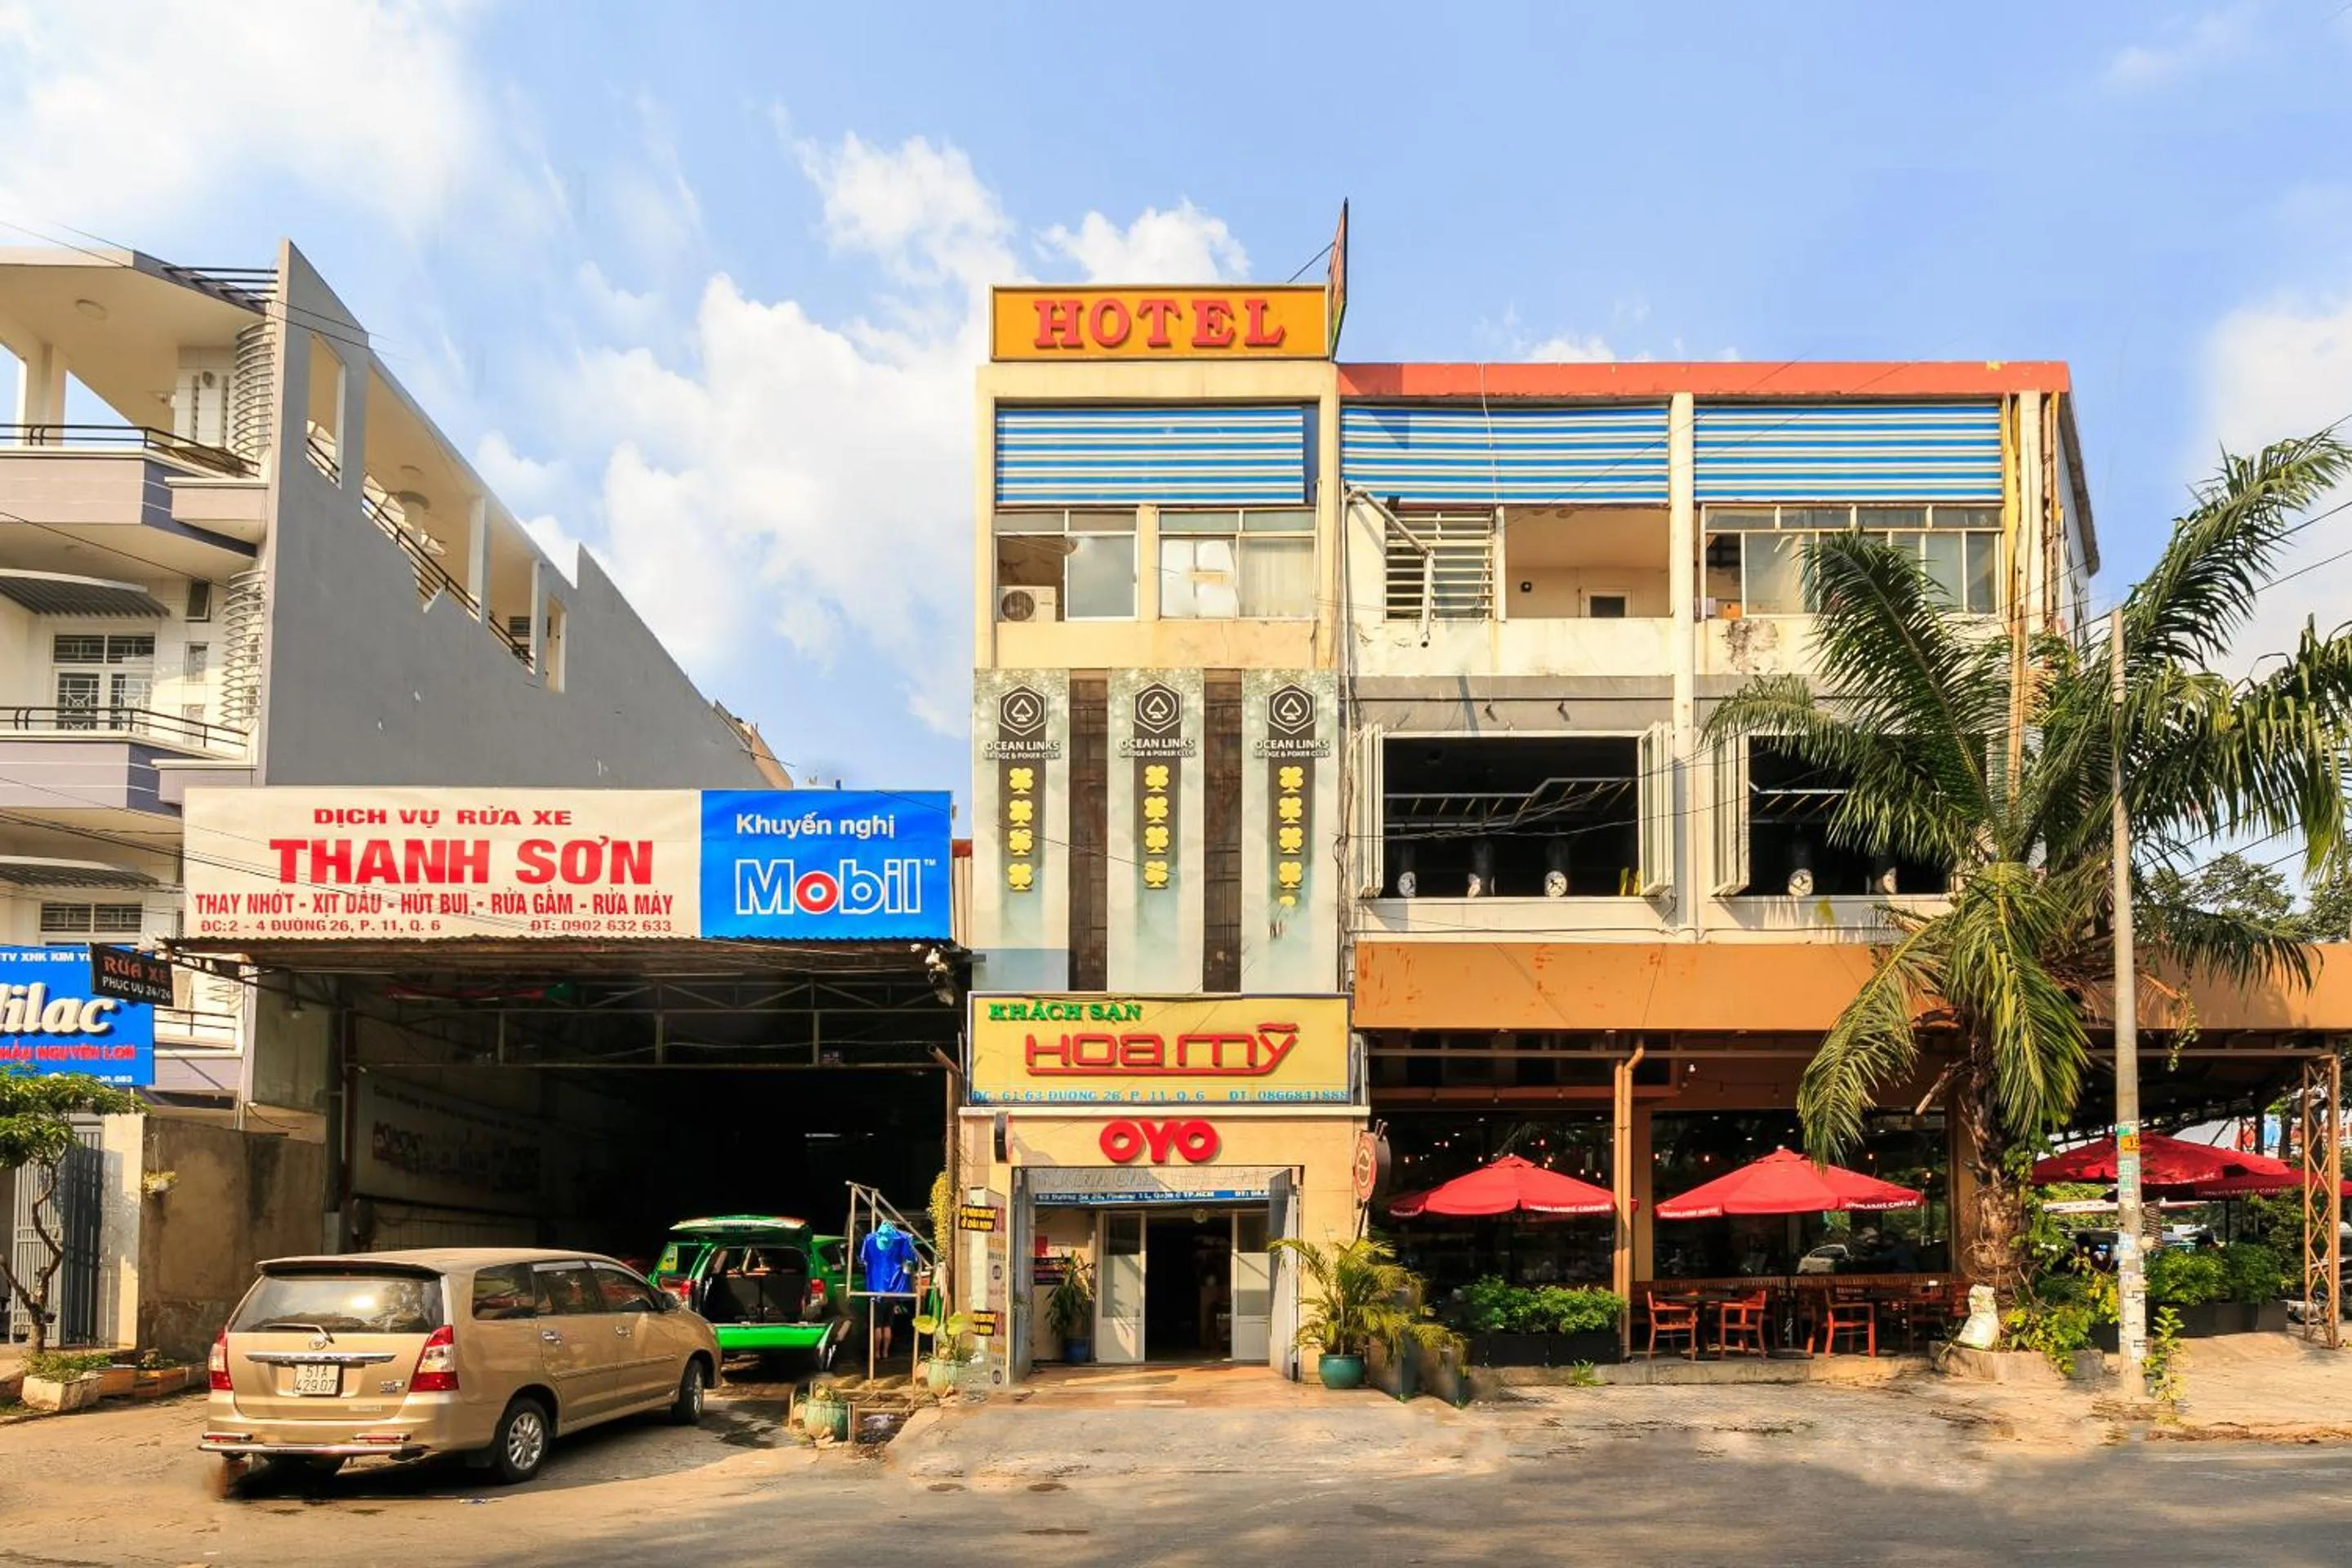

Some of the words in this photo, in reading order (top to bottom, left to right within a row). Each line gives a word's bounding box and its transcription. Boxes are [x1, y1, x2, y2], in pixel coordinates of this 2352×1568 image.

[1033, 297, 1287, 349] HOTEL
[985, 740, 1024, 751] OCEAN
[1027, 740, 1060, 751] LINKS
[1120, 737, 1160, 749] OCEAN
[1161, 737, 1195, 749] LINKS
[1254, 739, 1294, 749] OCEAN
[1296, 739, 1330, 749] LINKS
[314, 808, 387, 829] DỊCH
[399, 808, 439, 829] VỤ
[457, 805, 522, 826] RỬA
[532, 810, 572, 826] XE
[736, 813, 831, 840] Khuyến
[840, 815, 895, 840] nghị
[270, 839, 490, 884] THANH
[515, 835, 653, 884] SƠN
[735, 858, 921, 915] Mobil
[195, 894, 241, 914] THAY
[247, 889, 294, 914] NHỚT
[313, 893, 340, 917] XỊT
[330, 920, 354, 933] 26,
[360, 920, 375, 932] P.
[382, 920, 403, 933] 11,
[431, 920, 441, 931] 6
[562, 920, 601, 932] 0902
[608, 920, 637, 932] 632
[643, 920, 671, 932] 633
[989, 1000, 1082, 1021] KHÁCH
[1089, 1003, 1143, 1024] SẠN
[1099, 1119, 1219, 1163] OYO
